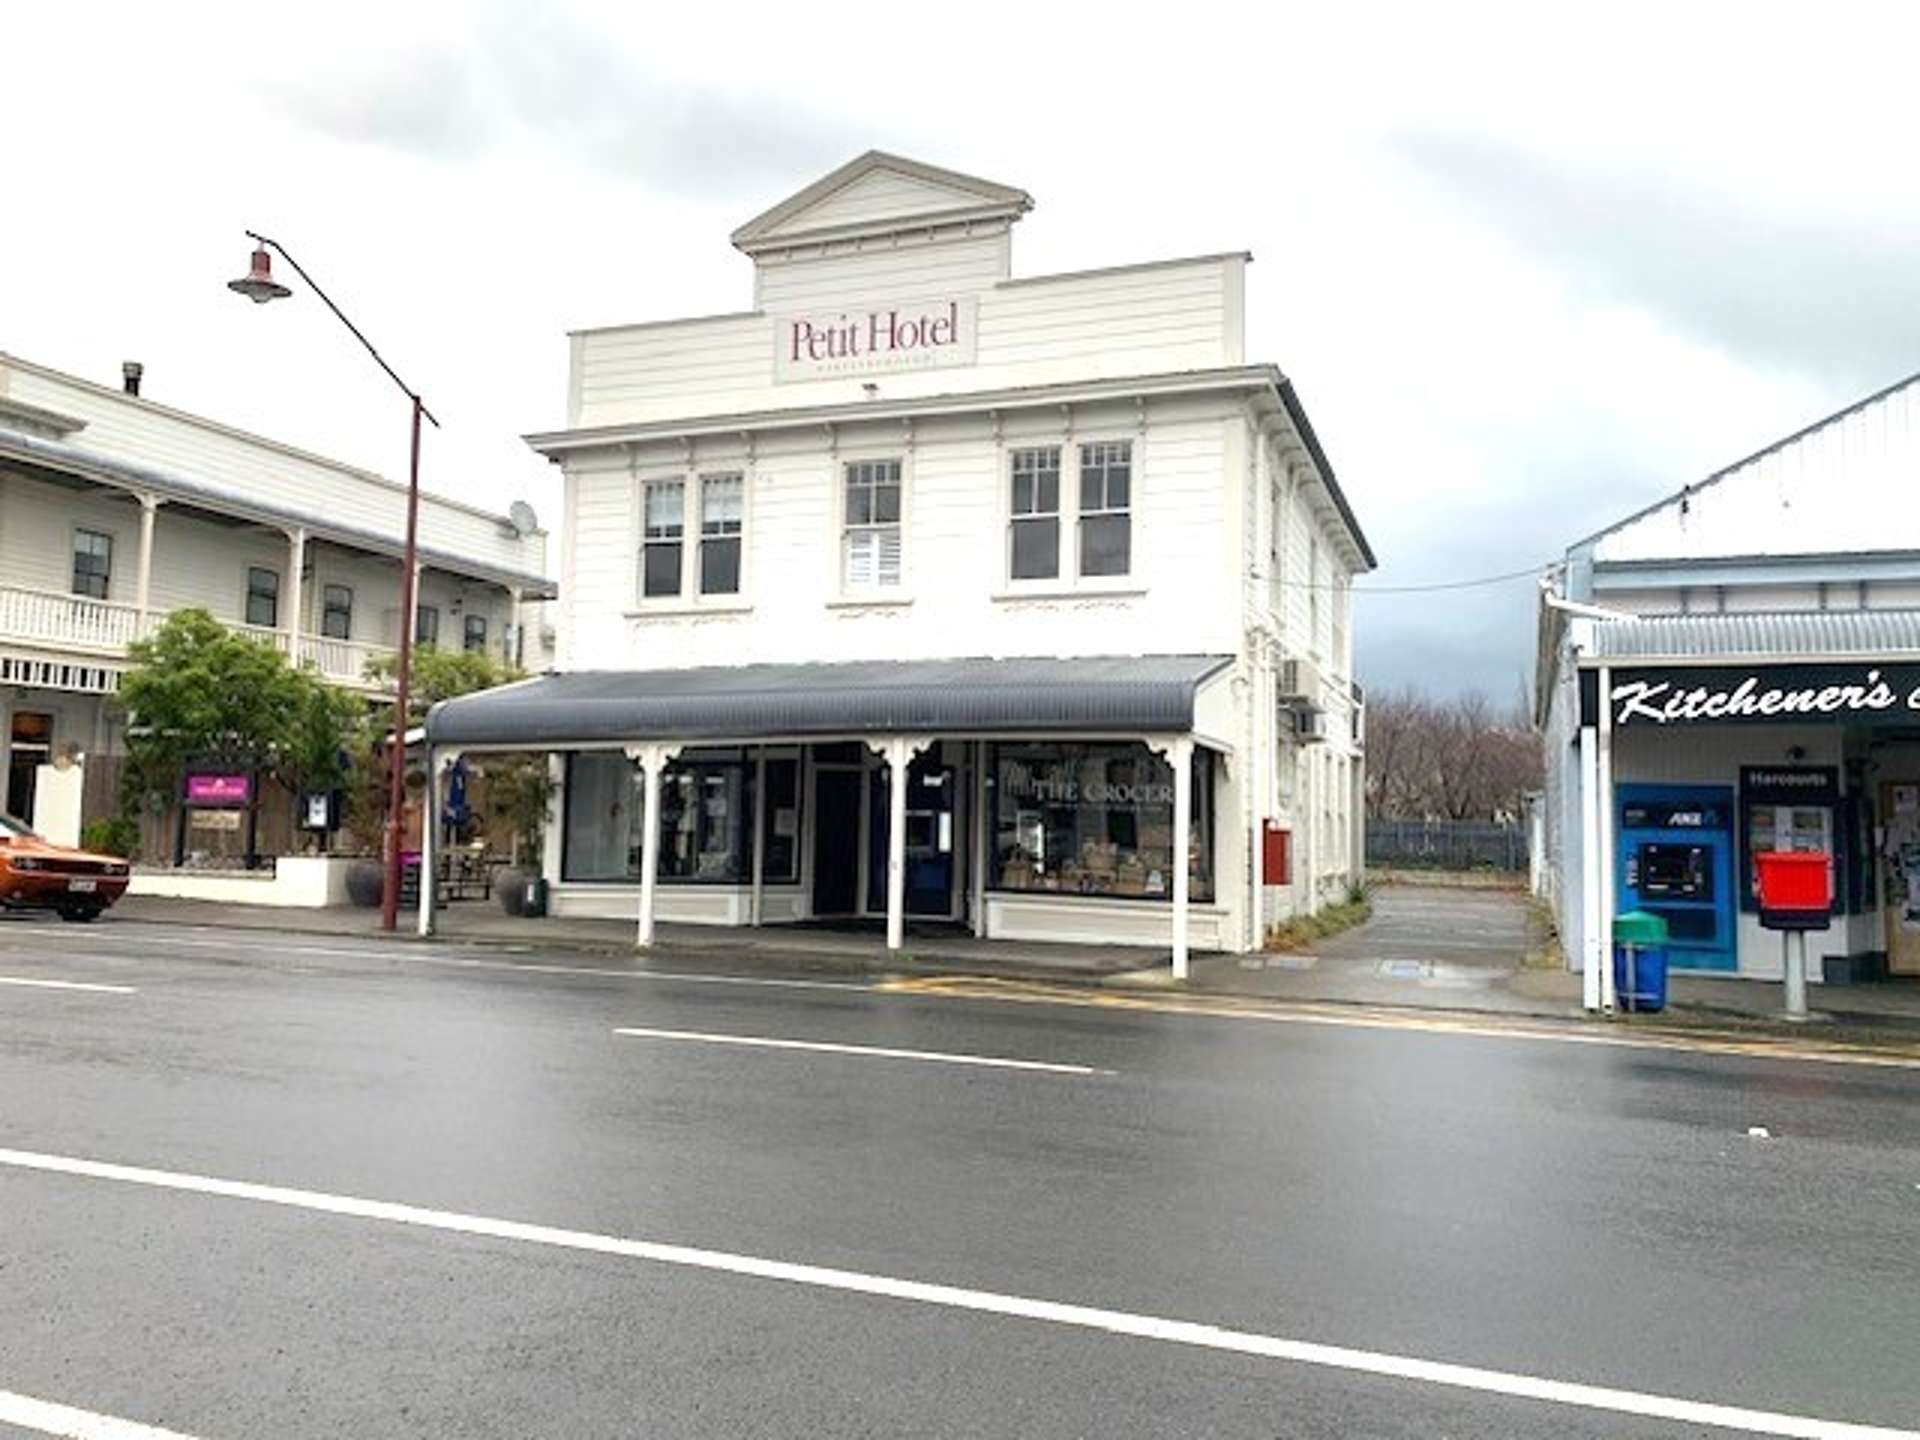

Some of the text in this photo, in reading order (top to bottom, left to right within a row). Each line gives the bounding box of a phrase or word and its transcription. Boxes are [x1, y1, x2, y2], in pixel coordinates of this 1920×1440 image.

[791, 302, 957, 361] Petit Hotel
[1611, 670, 1896, 724] Kitchener's
[1032, 779, 1078, 801] THE
